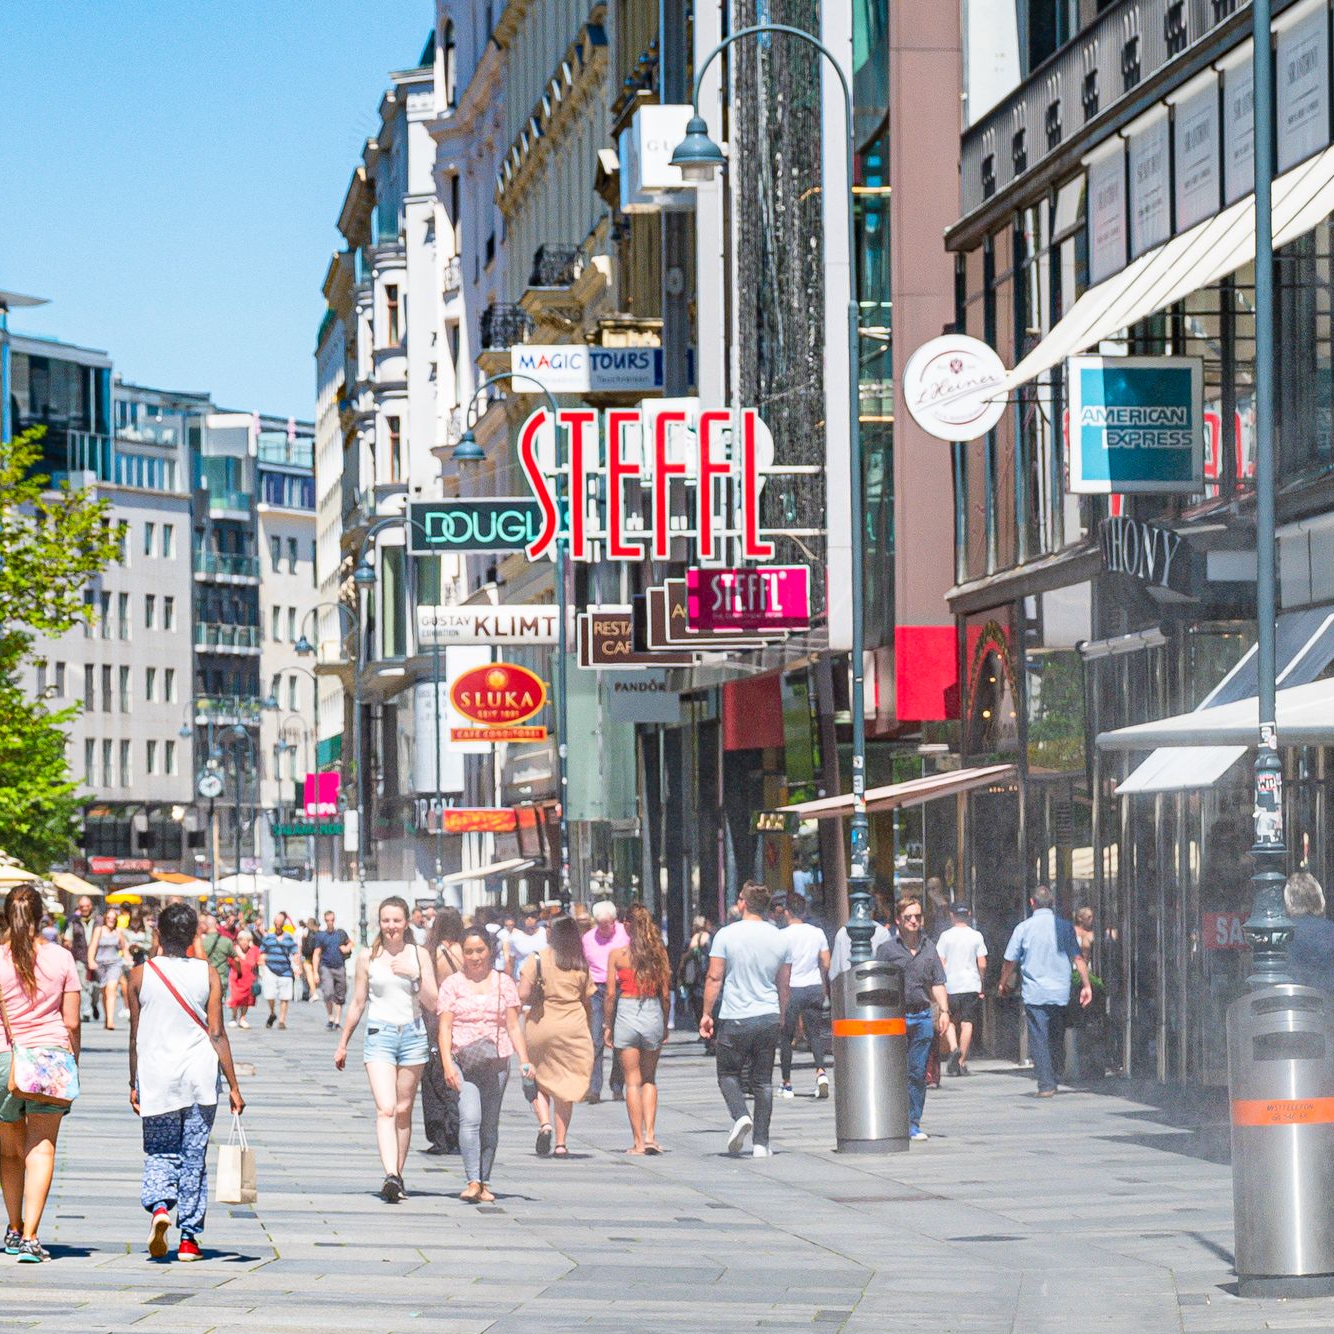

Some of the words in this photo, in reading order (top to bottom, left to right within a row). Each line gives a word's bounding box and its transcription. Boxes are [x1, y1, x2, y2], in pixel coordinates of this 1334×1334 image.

[519, 353, 582, 370] MAGIC
[590, 352, 650, 371] TOURS
[1081, 405, 1187, 428] AMERICAN
[1103, 427, 1193, 449] EXPRESS
[520, 407, 774, 561] STEFFL
[710, 572, 783, 612] STEFFL
[474, 616, 556, 637] KLIMT
[460, 691, 534, 708] SLUKA
